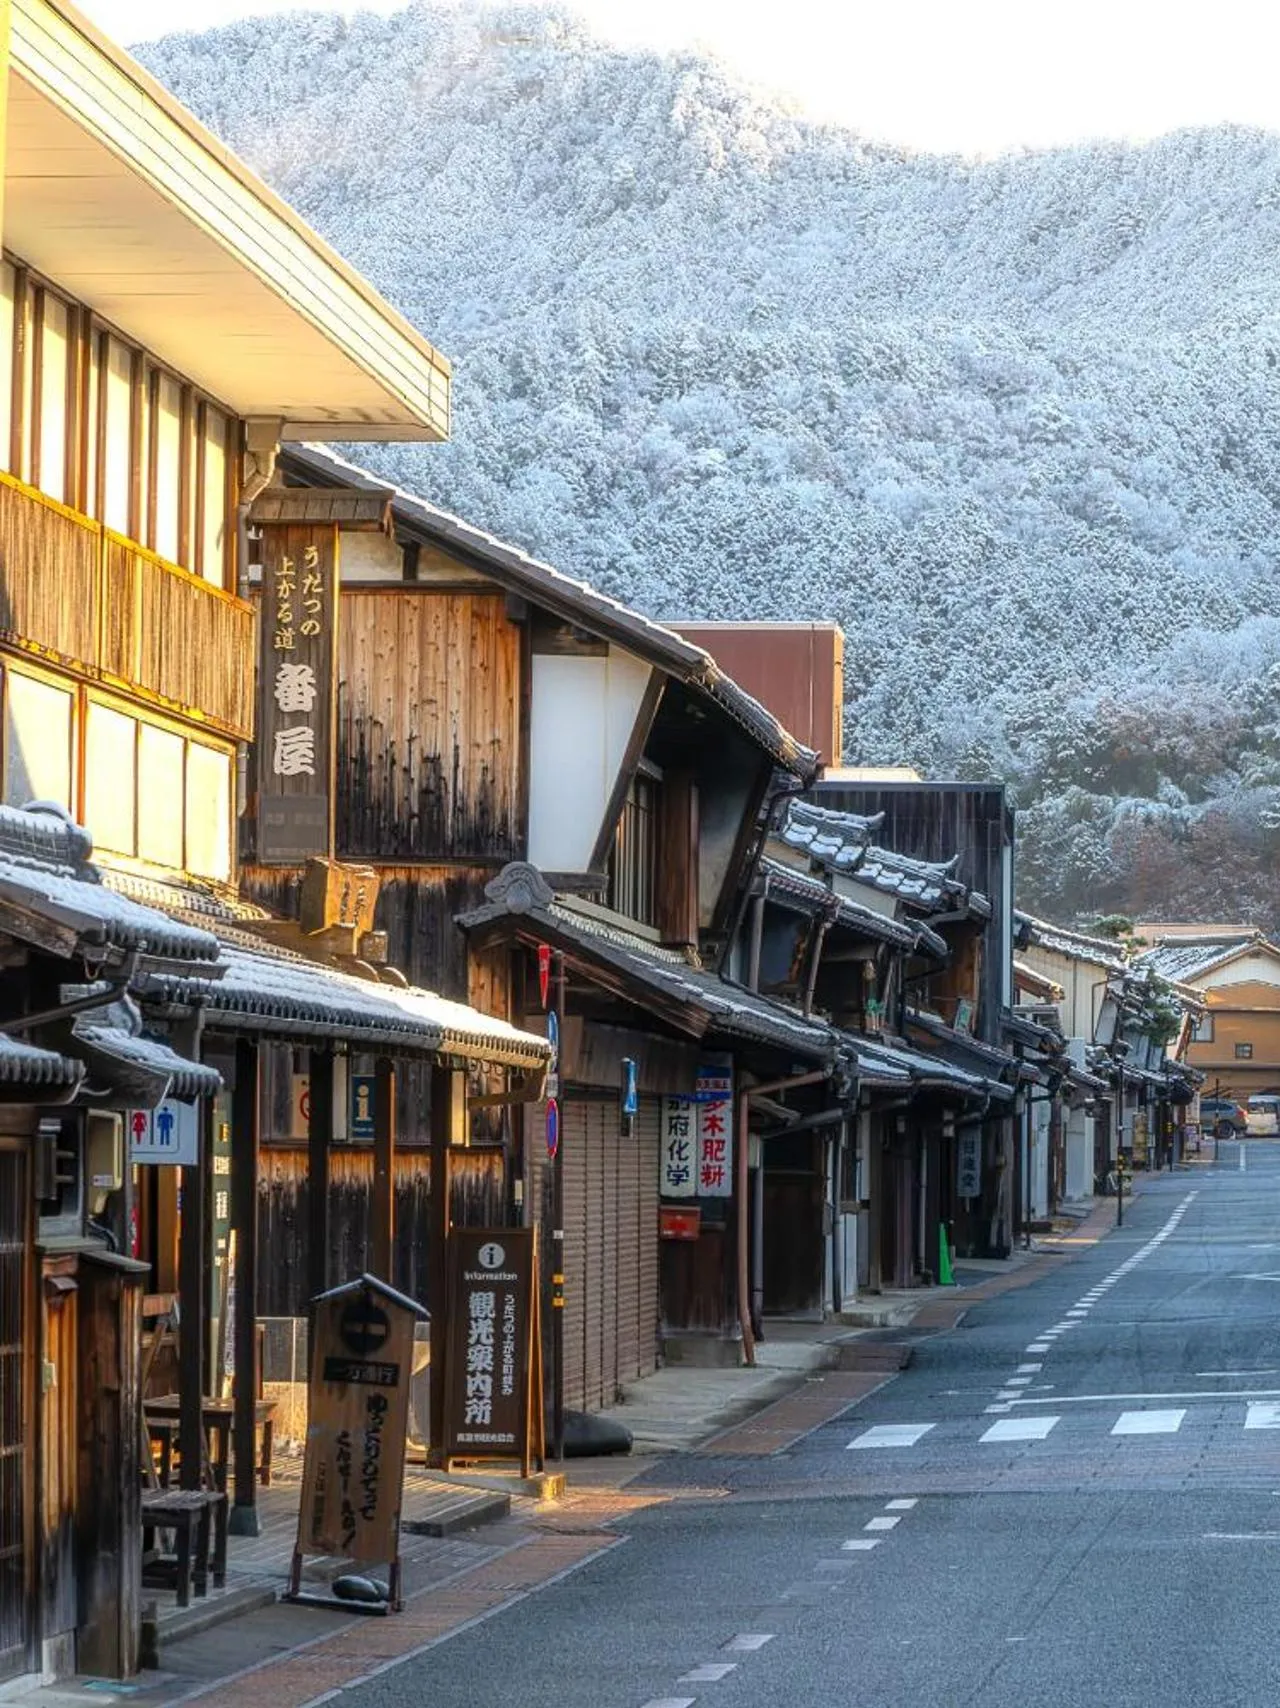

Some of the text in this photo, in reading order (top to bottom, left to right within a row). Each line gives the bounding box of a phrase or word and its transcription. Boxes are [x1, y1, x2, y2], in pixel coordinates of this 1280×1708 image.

[274, 663, 317, 775] 番屋
[701, 1099, 726, 1188] 多木肥料
[465, 1292, 496, 1424] 観光案内所
